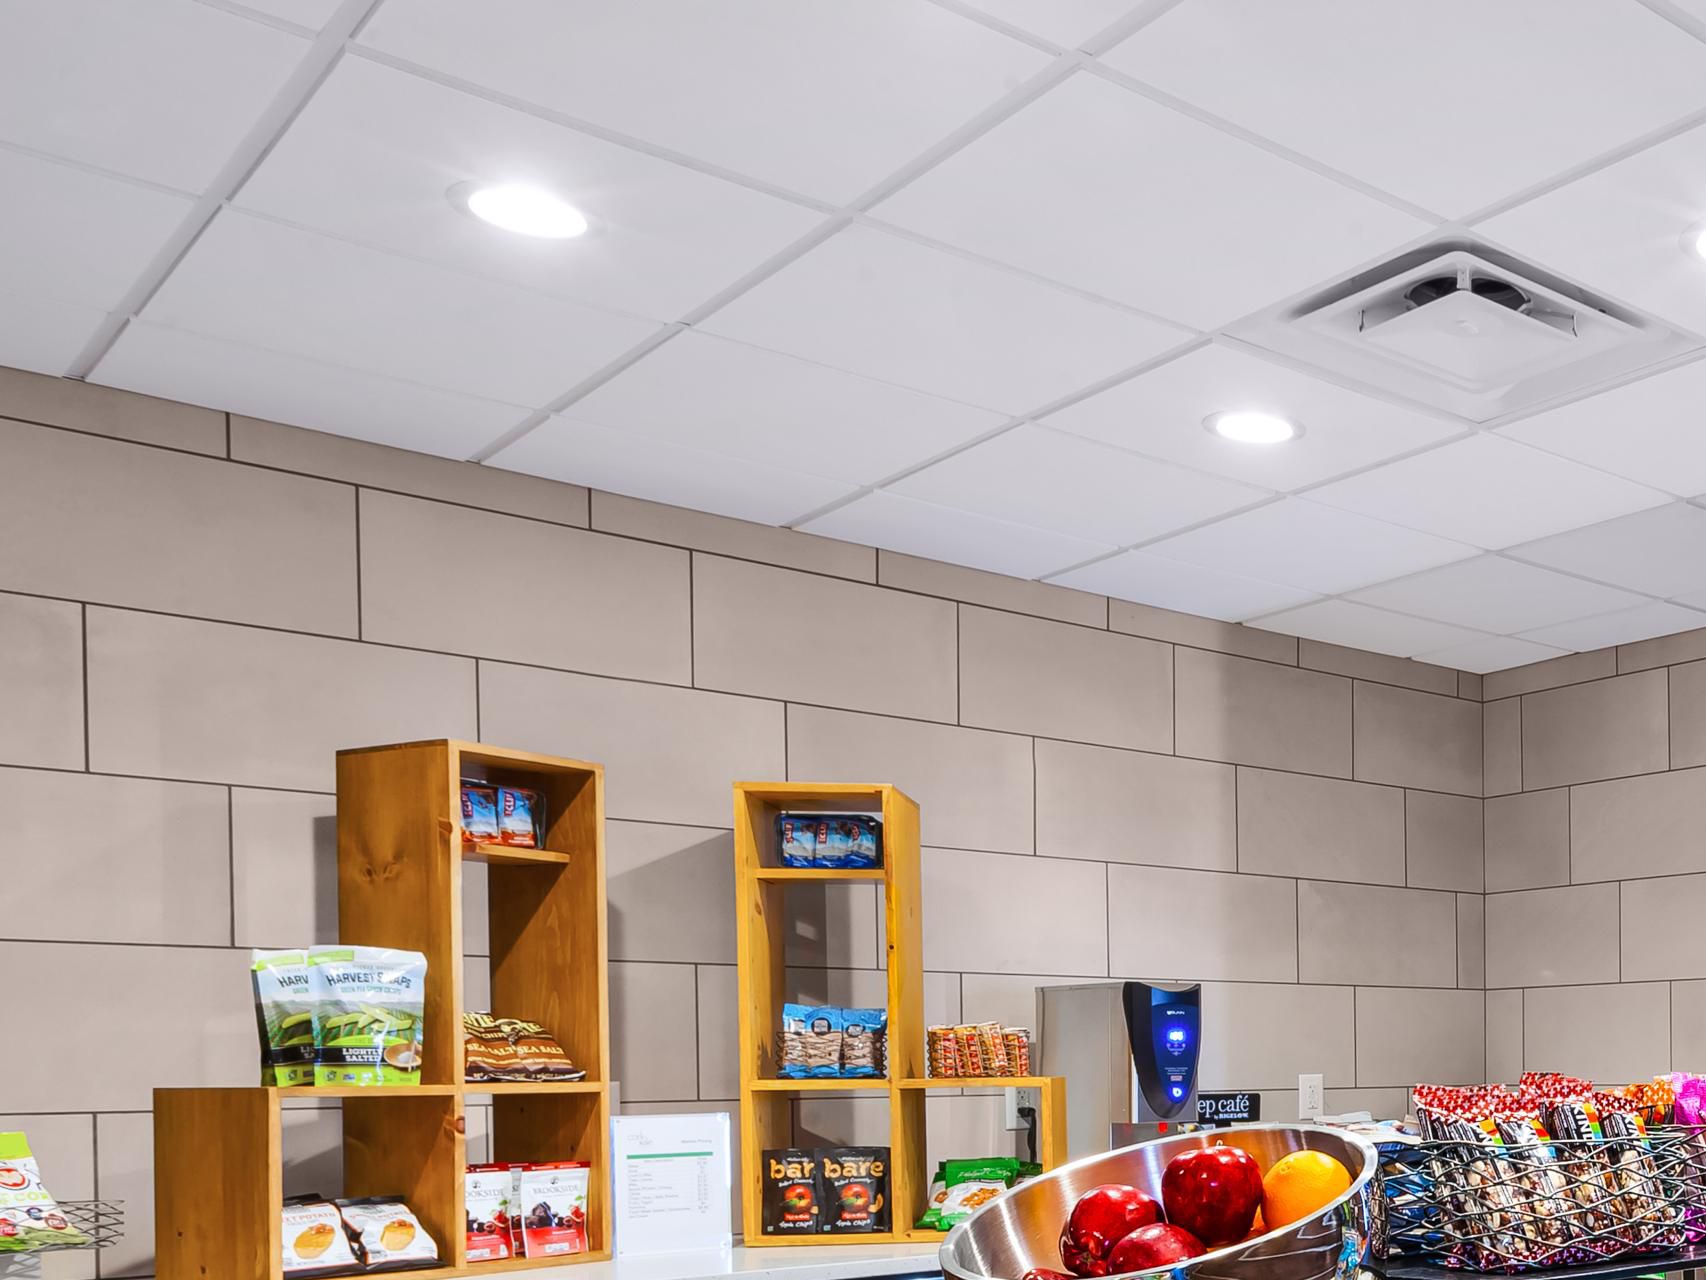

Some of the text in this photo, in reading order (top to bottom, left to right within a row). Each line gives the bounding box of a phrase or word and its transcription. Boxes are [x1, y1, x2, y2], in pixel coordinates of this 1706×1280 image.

[278, 975, 309, 987] HARV
[326, 972, 412, 989] HARVEST SAPS
[1218, 1095, 1249, 1112] café
[769, 1159, 815, 1179] bar
[823, 1157, 884, 1178] bare
[532, 1185, 579, 1195] BROOKSIDE
